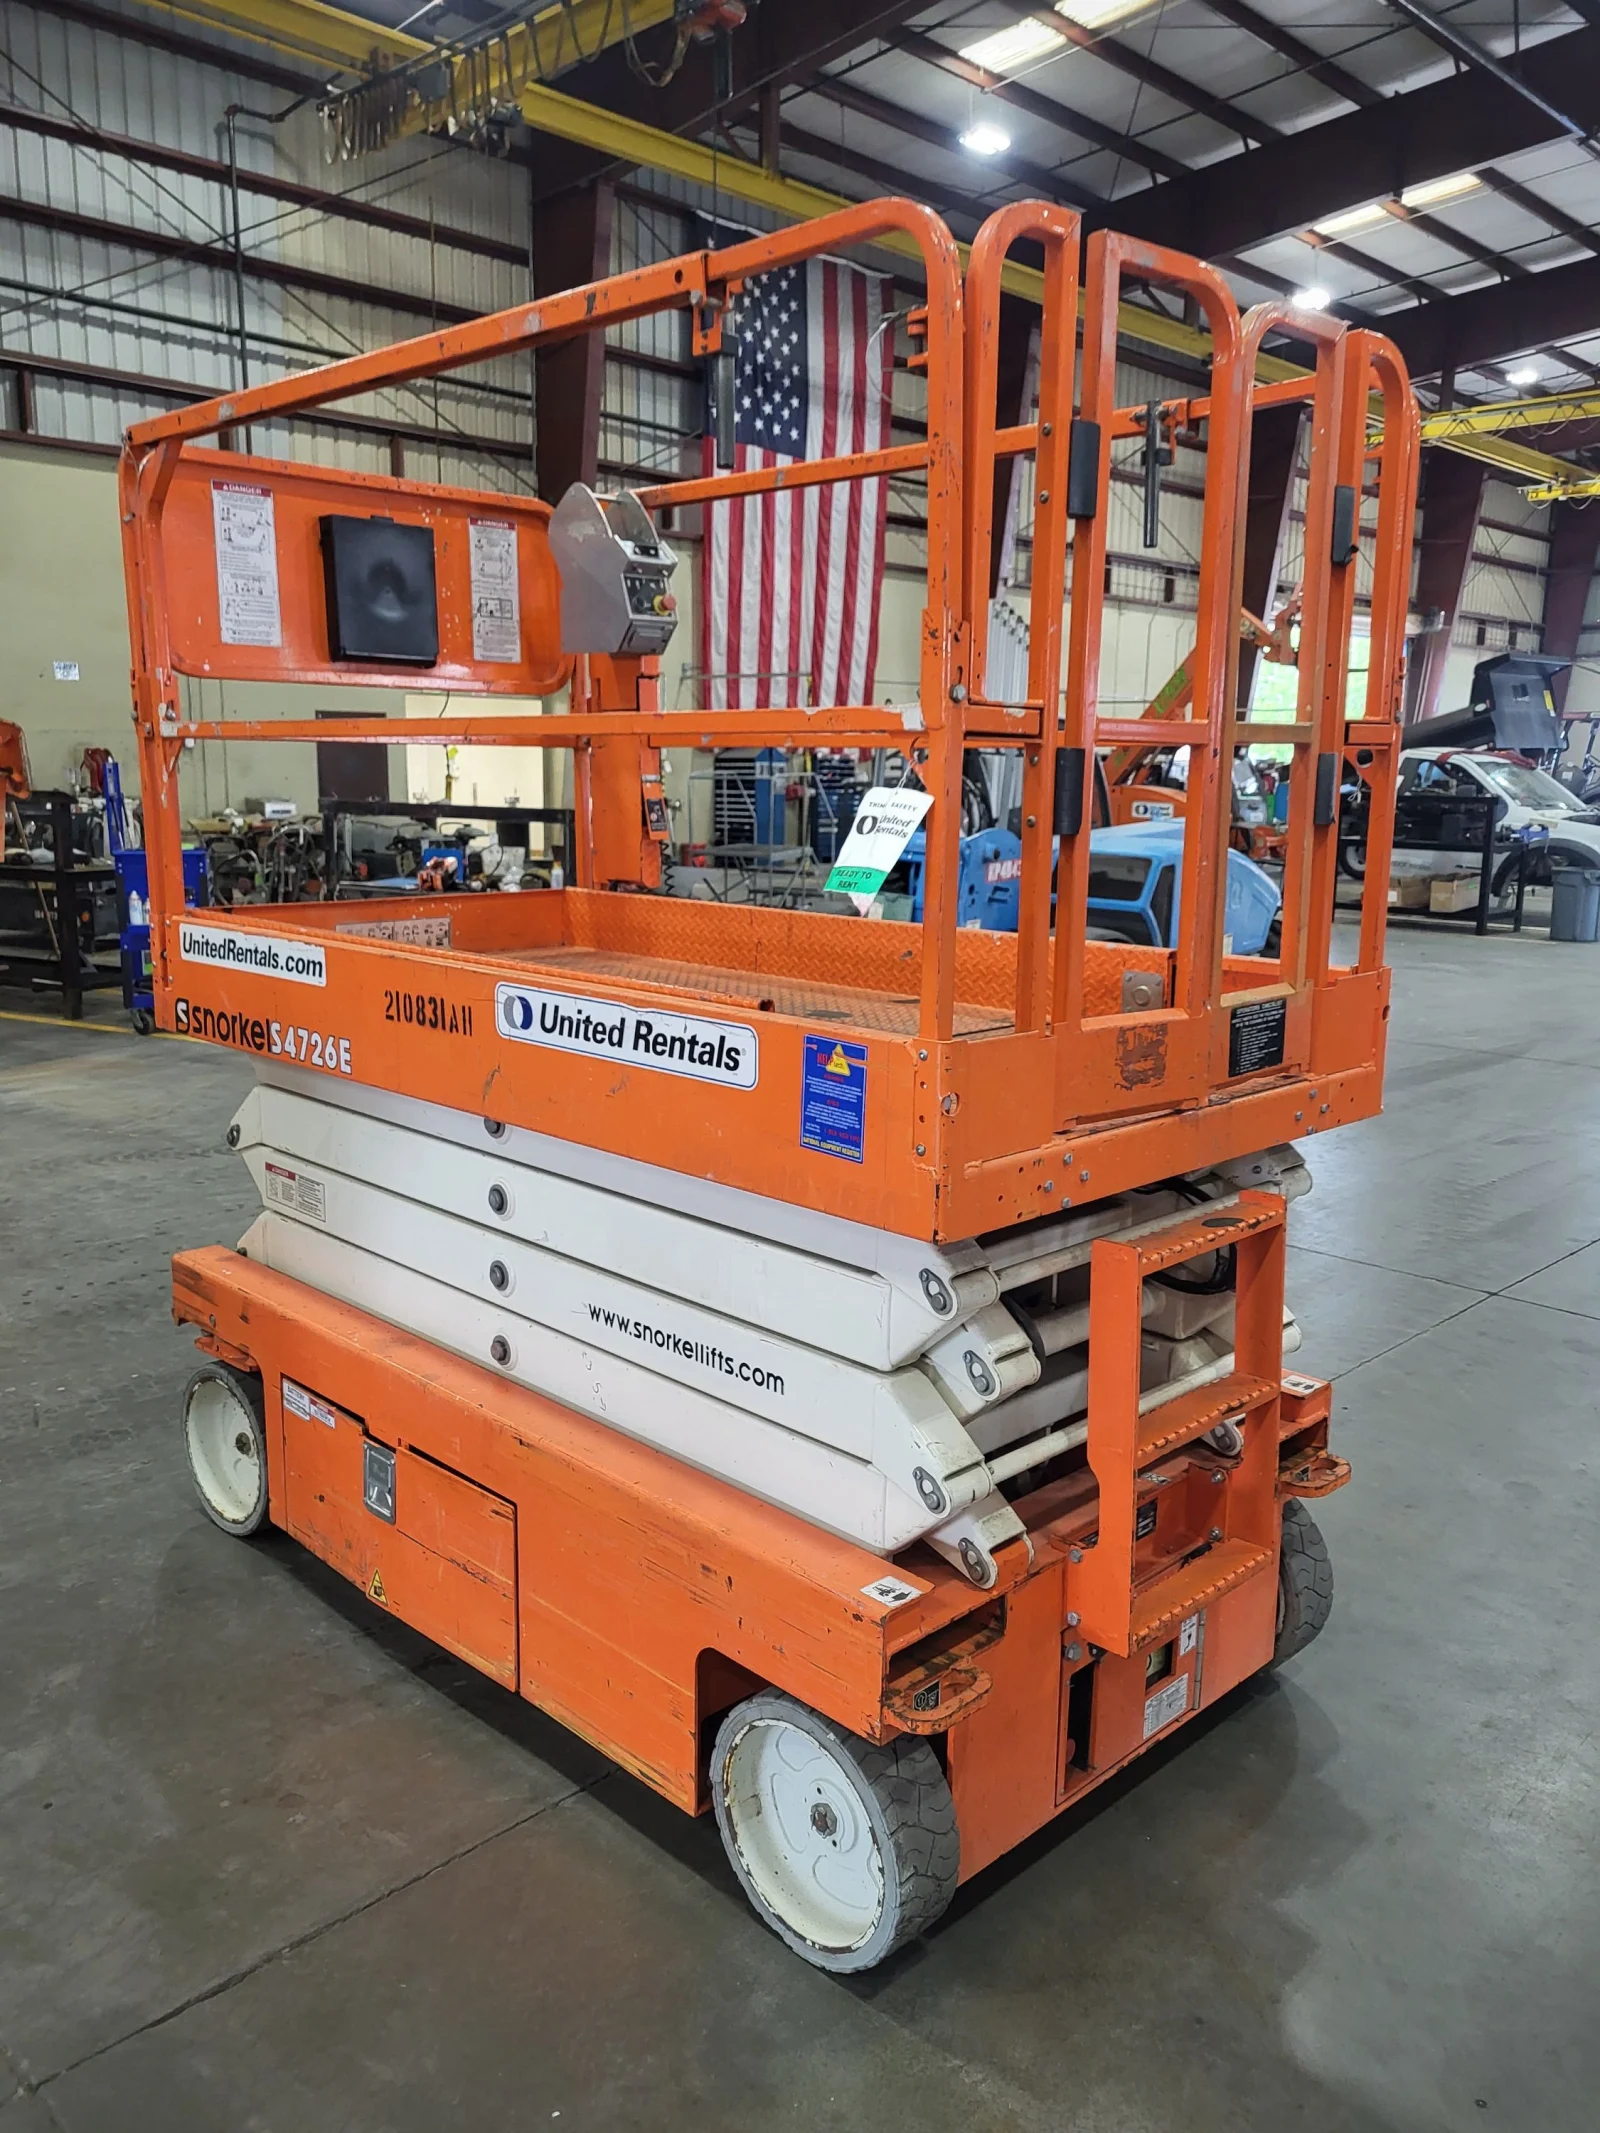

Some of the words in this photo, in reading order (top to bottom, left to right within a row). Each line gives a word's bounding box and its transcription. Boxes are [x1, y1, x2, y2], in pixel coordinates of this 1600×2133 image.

[891, 802, 918, 811] SAFETY
[837, 880, 858, 889] RENT
[861, 870, 872, 879] TO
[183, 932, 323, 978] UnitedRentals.com
[270, 1021, 353, 1075] S4726E
[540, 1003, 626, 1048] United
[632, 1019, 742, 1072] Rentals
[588, 1303, 785, 1396] www.snorkellifts.com
